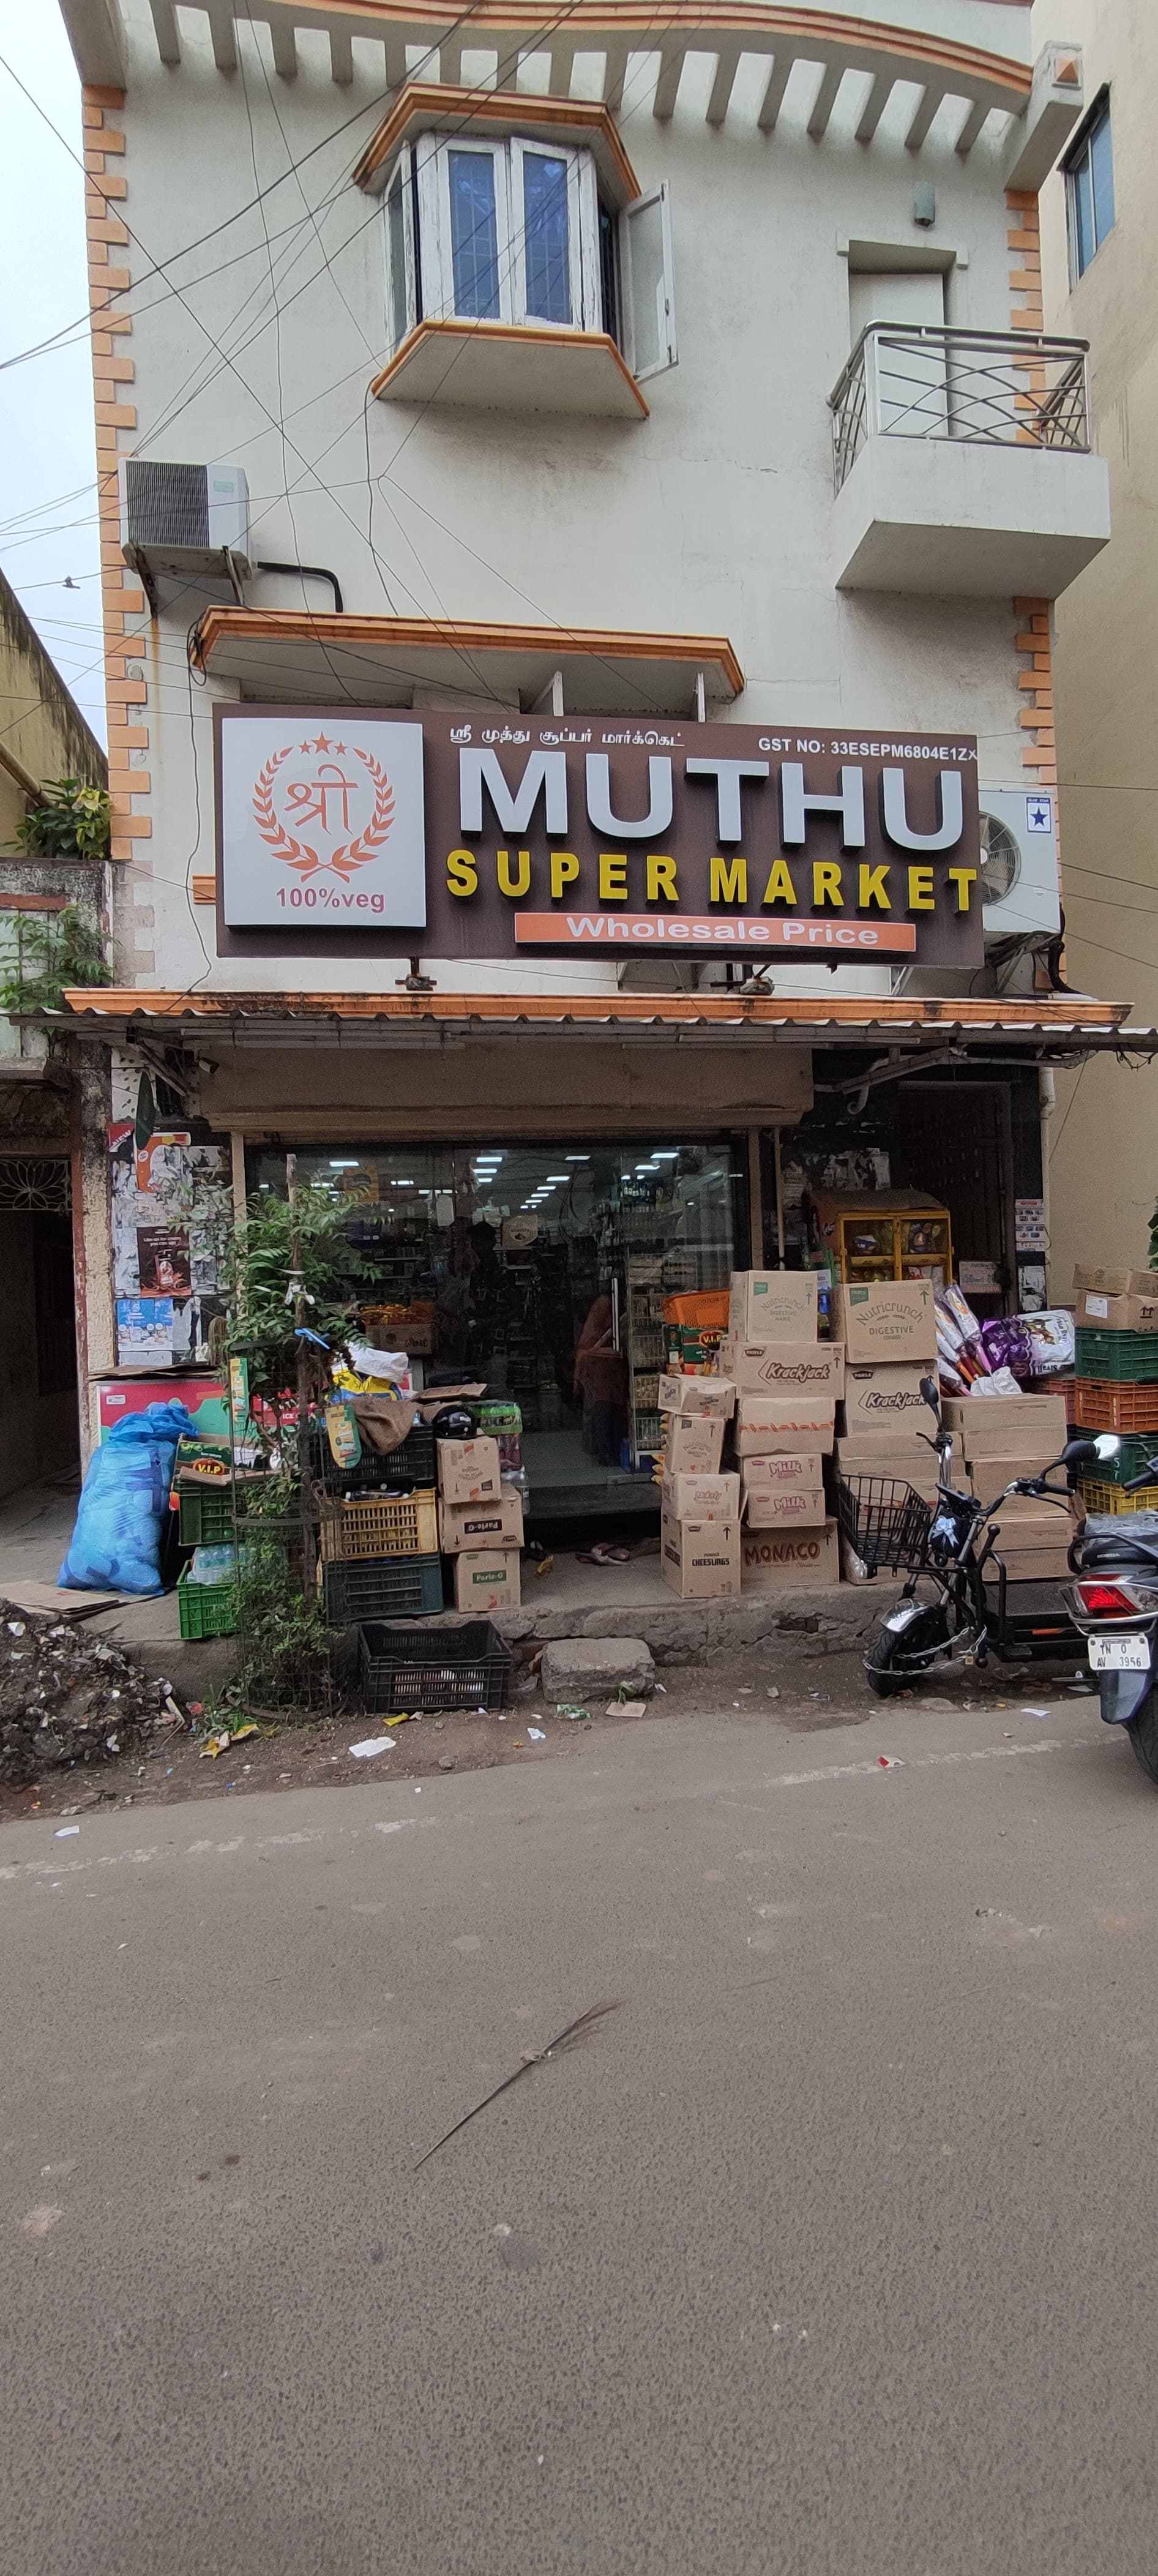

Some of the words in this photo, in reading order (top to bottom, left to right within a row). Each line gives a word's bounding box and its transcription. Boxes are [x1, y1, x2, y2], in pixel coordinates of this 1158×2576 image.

[481, 725, 530, 744] முத்து
[539, 727, 592, 746] சூப்பர்
[602, 730, 685, 747] மார்க்கெட்
[758, 738, 791, 752] GST
[796, 739, 826, 754] NO:
[283, 764, 359, 836] श्री
[459, 747, 963, 851] MUTHU
[447, 849, 679, 901] SUPER
[710, 858, 977, 912] MARKET
[275, 888, 386, 913] 100%veg
[566, 916, 769, 940] Wholesale
[782, 923, 879, 945] Price
[856, 1301, 924, 1326] Nutricrunch
[869, 1326, 914, 1335] DIGESTIVE
[766, 1362, 831, 1383] Krackjack
[198, 1464, 221, 1474] V.I.P
[769, 1460, 802, 1475] Milk
[774, 1496, 806, 1511] Milk
[692, 1558, 730, 1567] CHEESLINGS
[744, 1541, 820, 1568] MONACO
[476, 1573, 504, 1582] Parle-G
[1100, 1643, 1111, 1655] TN
[1097, 1657, 1106, 1668] AV
[1119, 1657, 1141, 1668] 3956
